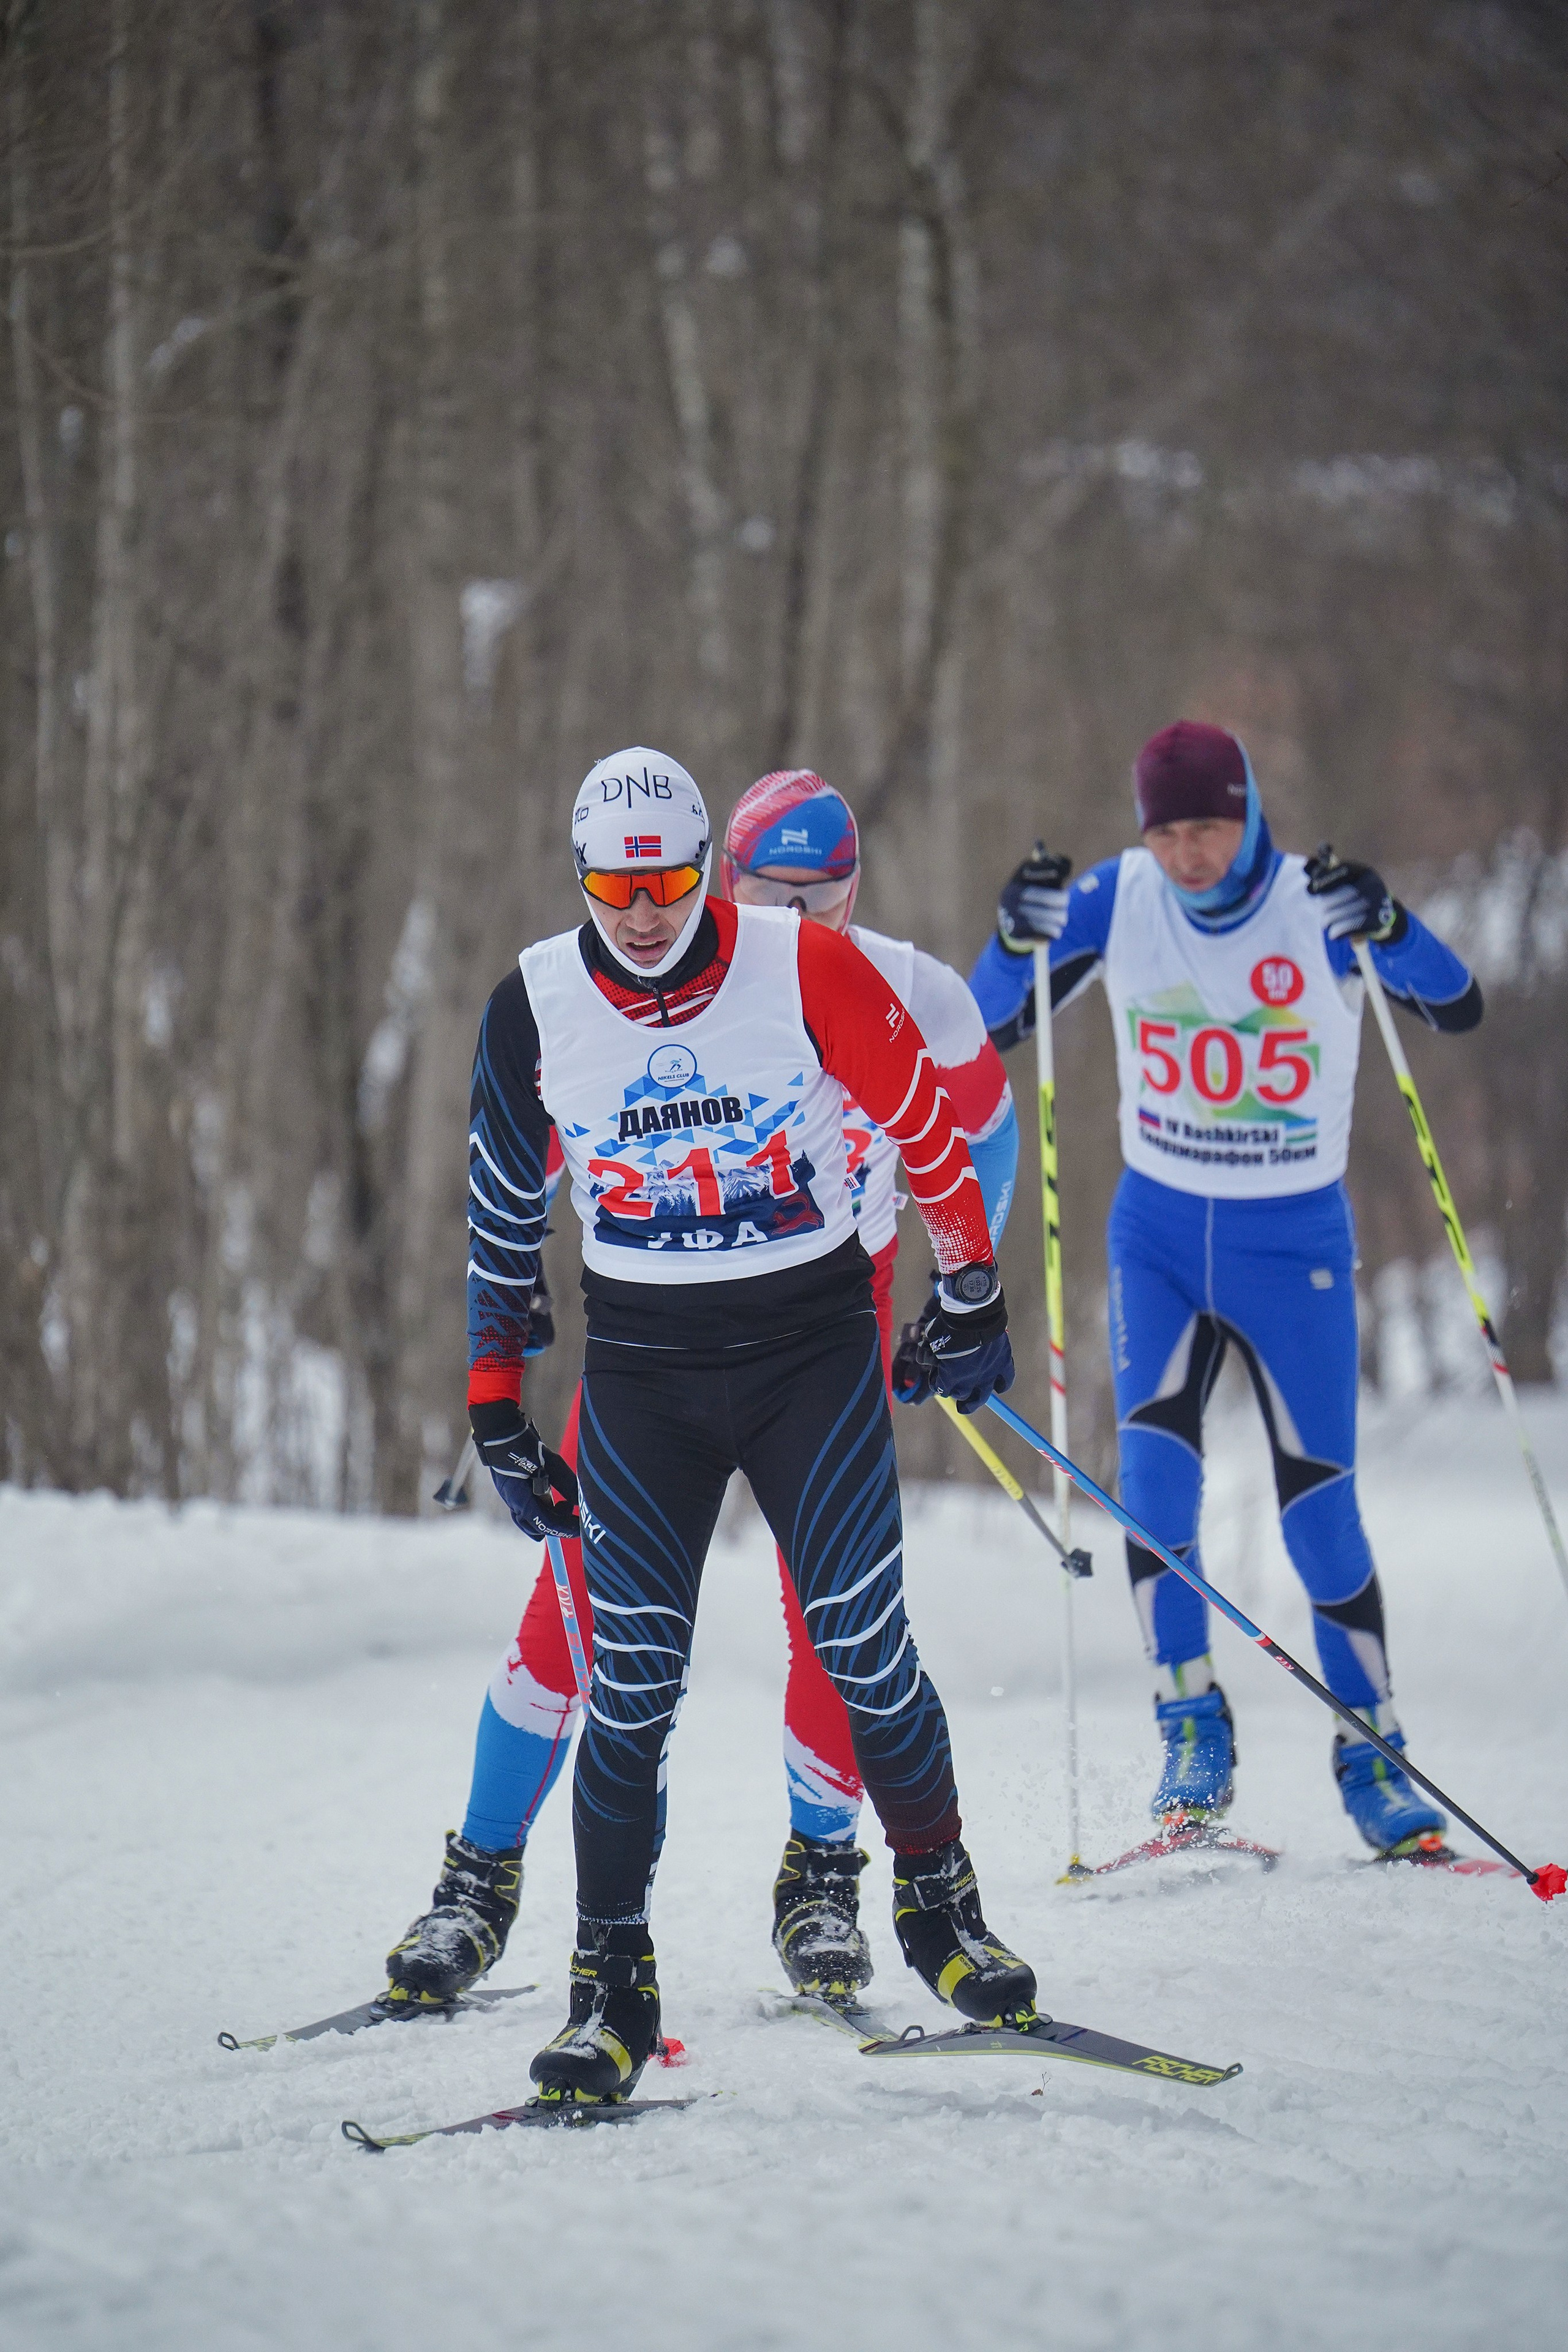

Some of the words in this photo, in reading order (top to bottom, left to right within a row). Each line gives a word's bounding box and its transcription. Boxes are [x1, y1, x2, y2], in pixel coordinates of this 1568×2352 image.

[601, 767, 673, 809] DNB
[1139, 1020, 1311, 1104] 505
[618, 1096, 744, 1142] ДАЯНОВ
[588, 1130, 796, 1217] 211
[646, 1221, 768, 1250] УФА
[533, 1516, 573, 1538] NORDSKI
[570, 1966, 598, 1978] CHER
[1132, 2056, 1223, 2084] FISCHER
